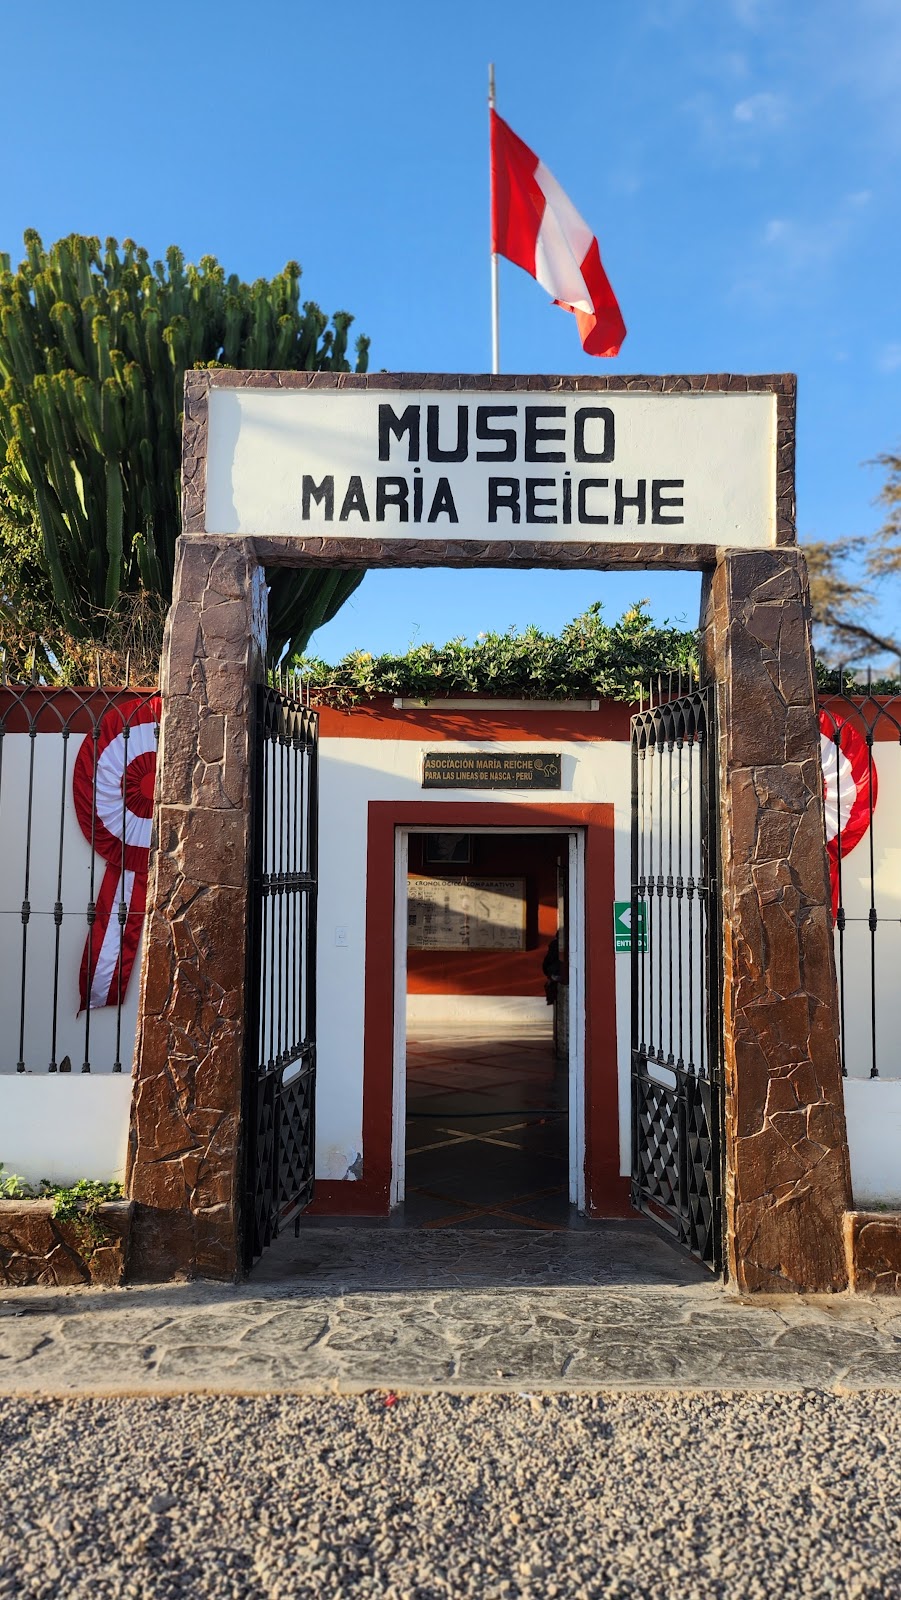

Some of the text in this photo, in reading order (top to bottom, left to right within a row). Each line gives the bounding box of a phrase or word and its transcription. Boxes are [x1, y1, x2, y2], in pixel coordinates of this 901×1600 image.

[378, 404, 615, 462] MUSEO
[425, 758, 533, 769] ASOCIACIÓN MARÍA REICHE
[425, 771, 441, 780] PARA
[442, 771, 455, 780] LAS
[456, 771, 479, 780] LINEAS
[479, 771, 489, 780] DE
[489, 771, 511, 780] NASCA
